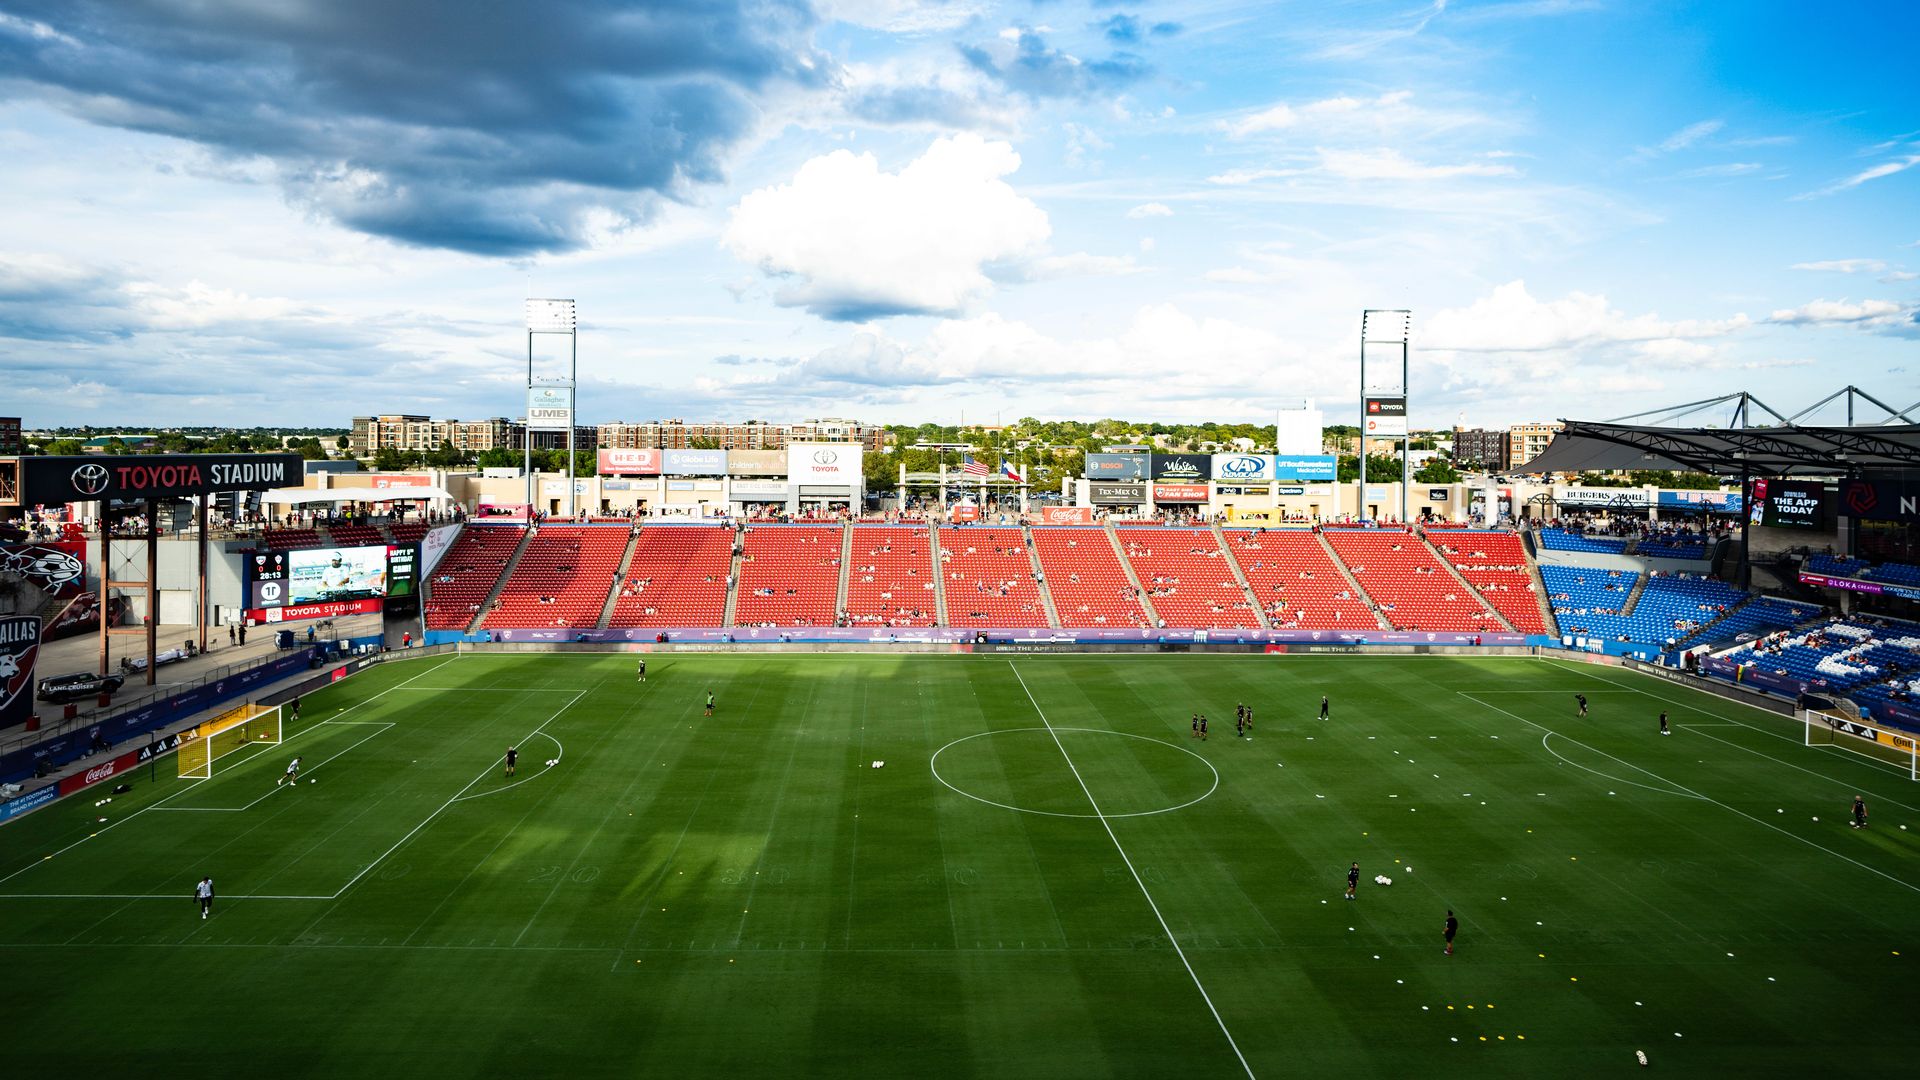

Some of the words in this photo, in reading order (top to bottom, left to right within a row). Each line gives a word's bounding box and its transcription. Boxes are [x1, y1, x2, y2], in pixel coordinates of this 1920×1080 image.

[531, 409, 569, 418] UMB
[680, 455, 702, 463] Globe
[704, 455, 720, 463] Life
[1163, 456, 1199, 472] WinStar
[117, 464, 203, 490] TOYOTA
[210, 461, 285, 485] STADIUM
[1131, 488, 1139, 497] Q
[1567, 491, 1611, 499] BURGERS
[1617, 493, 1646, 501] MORE
[1773, 497, 1793, 506] THE
[1795, 498, 1818, 507] APP
[1900, 495, 1920, 516] N
[1050, 509, 1083, 521] Coca-Cola
[1777, 505, 1814, 515] TODAY
[389, 549, 406, 557] HAPPY
[390, 555, 413, 563] BIRTHDAY
[259, 571, 282, 580] 28:13
[1834, 580, 1857, 589] LOKA
[1857, 584, 1881, 592] CREATIVE
[285, 607, 321, 617] TOYOTA
[324, 603, 362, 613] STADIUM
[384, 651, 401, 660] APP
[1655, 668, 1667, 677] THE
[1668, 672, 1682, 681] APP
[85, 761, 116, 784] Coca-Cola
[10, 803, 28, 815] BRAND
[33, 793, 54, 804] AMERICA
